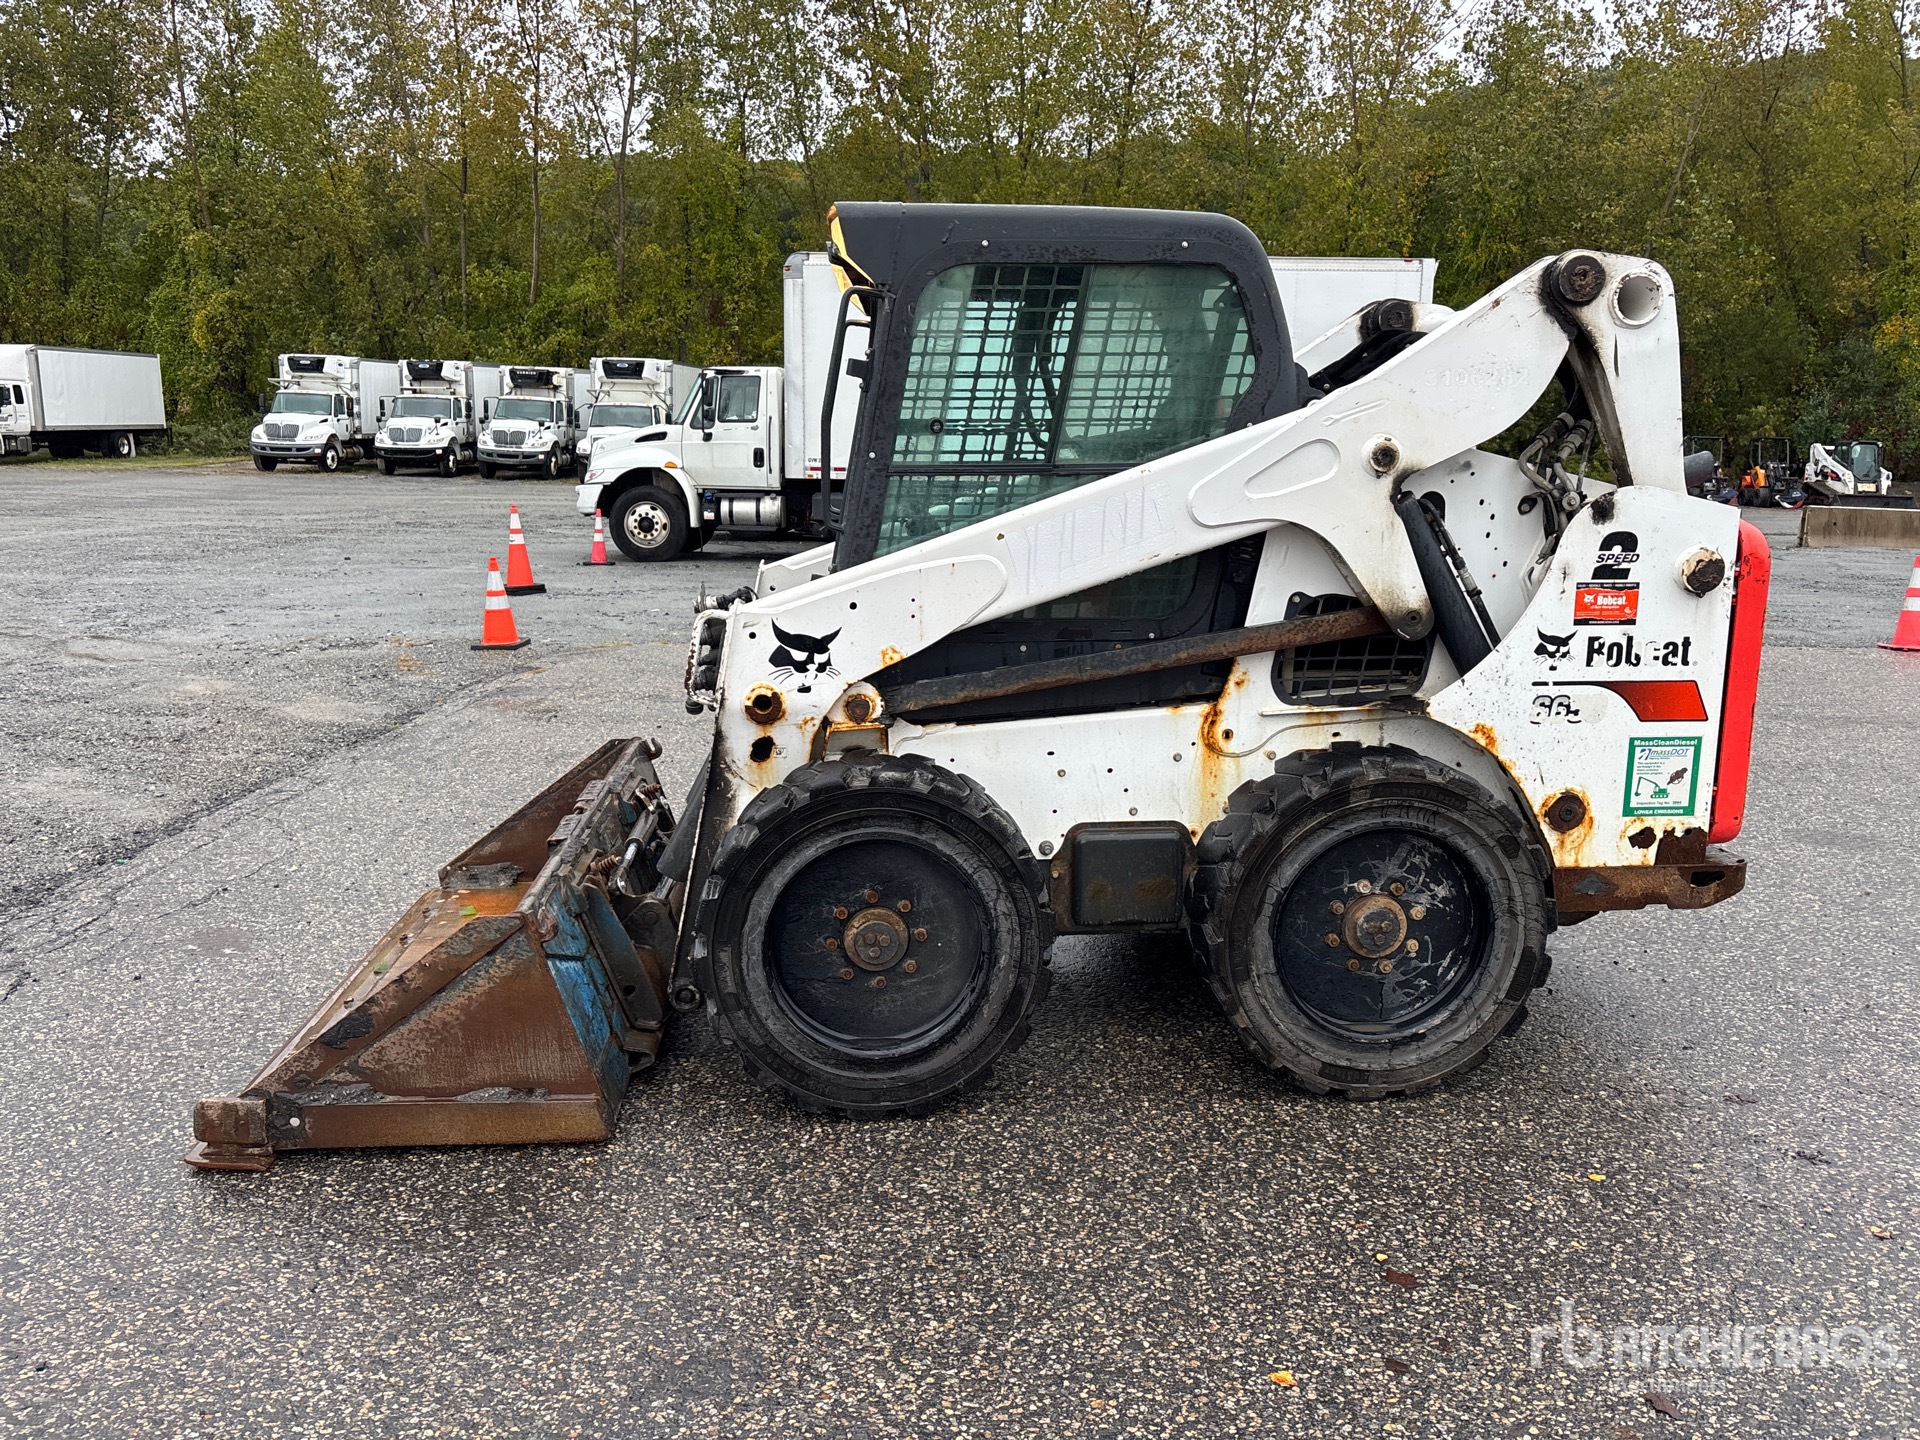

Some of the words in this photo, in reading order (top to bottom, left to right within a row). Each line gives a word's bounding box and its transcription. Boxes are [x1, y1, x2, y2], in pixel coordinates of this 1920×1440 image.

[1591, 531, 1639, 580] 2
[1595, 553, 1640, 564] SPEED
[1596, 595, 1627, 606] Bobcat
[1586, 636, 1691, 667] Bobat
[1650, 748, 1690, 756] massDOT
